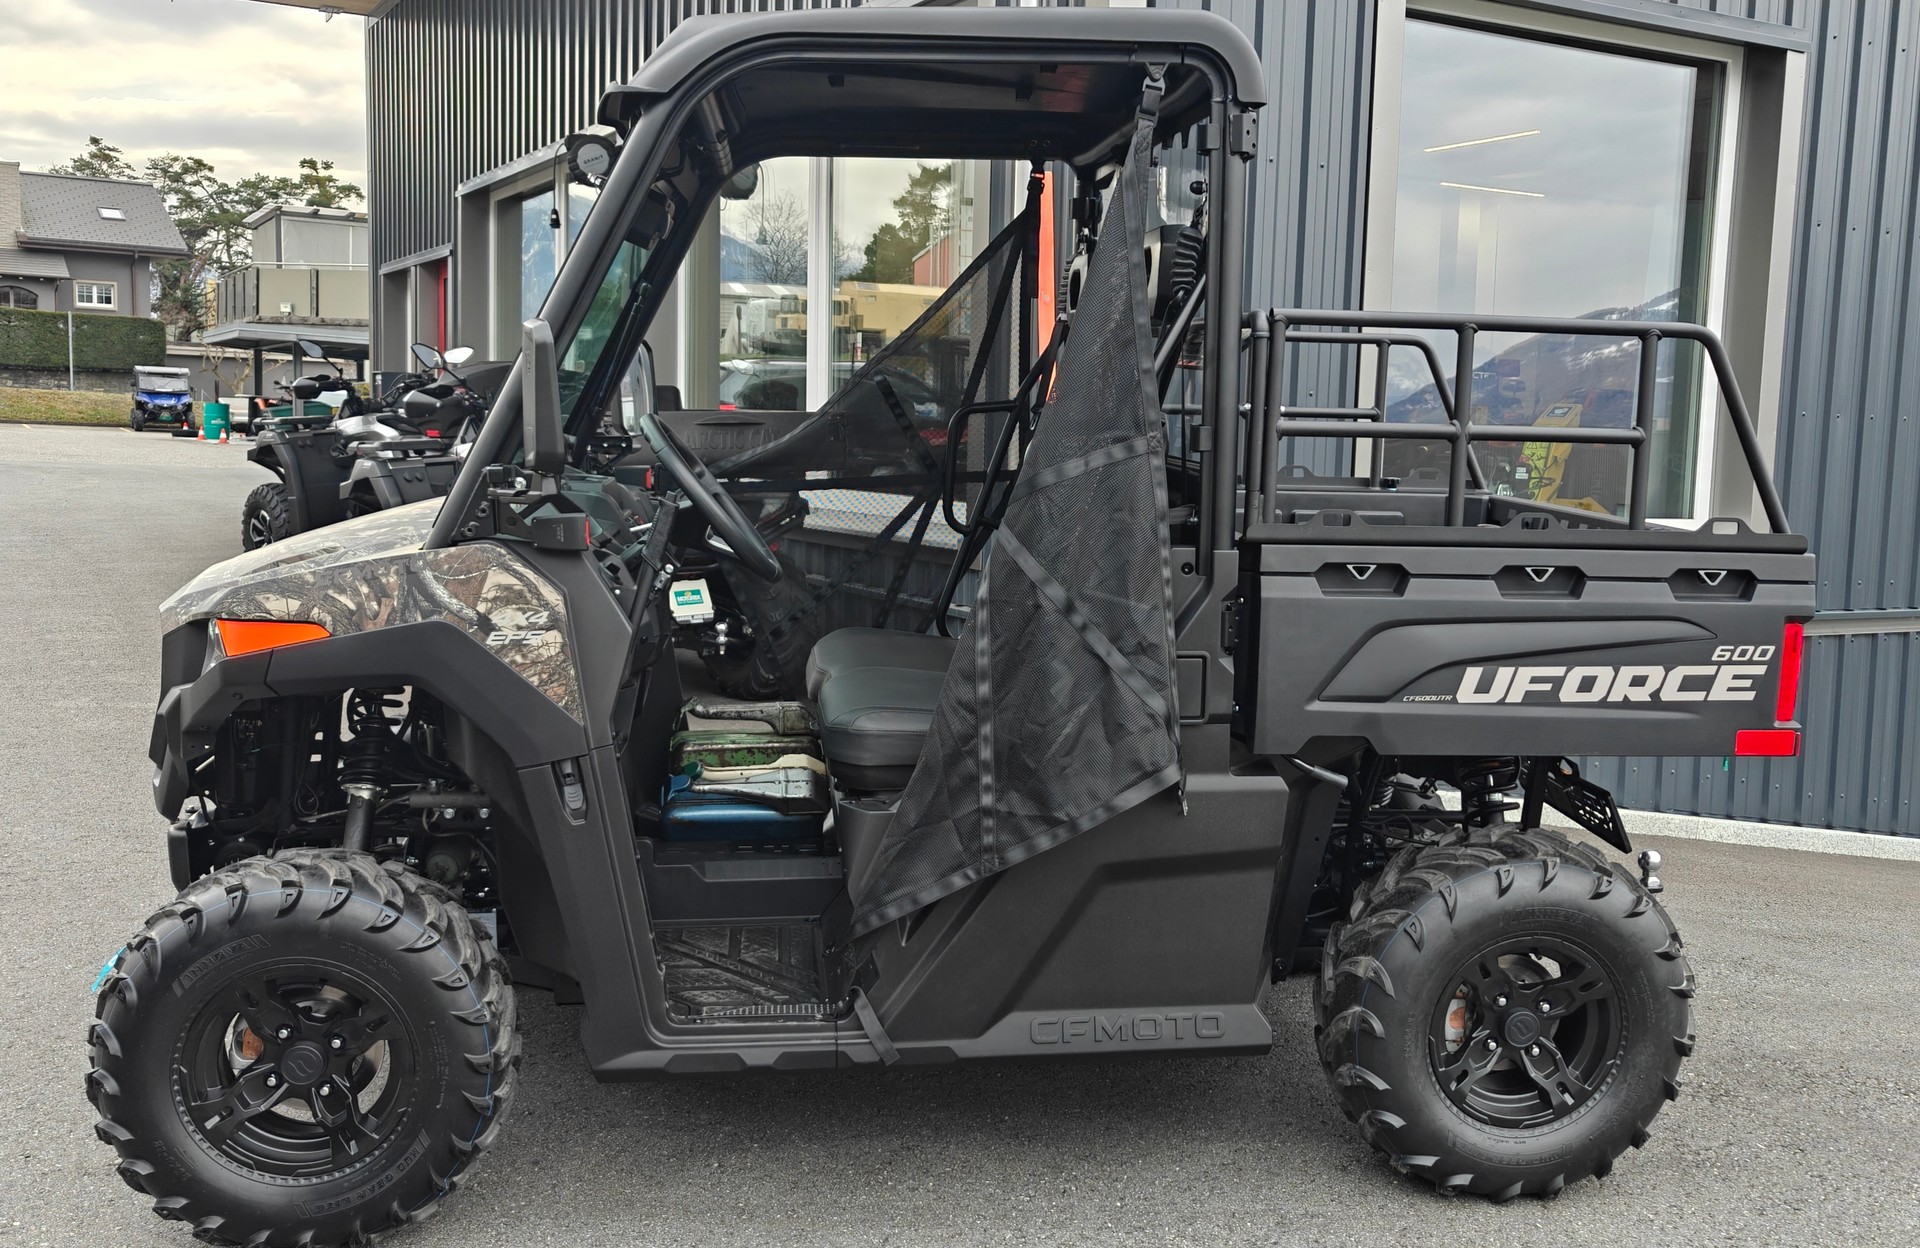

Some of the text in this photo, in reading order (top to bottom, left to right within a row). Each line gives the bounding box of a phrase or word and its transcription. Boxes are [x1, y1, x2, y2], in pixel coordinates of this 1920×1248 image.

[583, 154, 604, 165] GRANIT
[684, 428, 744, 450] ARCTIC
[486, 630, 547, 645] EPS
[1711, 645, 1776, 661] 600
[1455, 665, 1768, 703] UFORCE
[184, 941, 251, 983] INNOVA
[1030, 1011, 1226, 1044] CFMOTO
[397, 1146, 421, 1173] MUD
